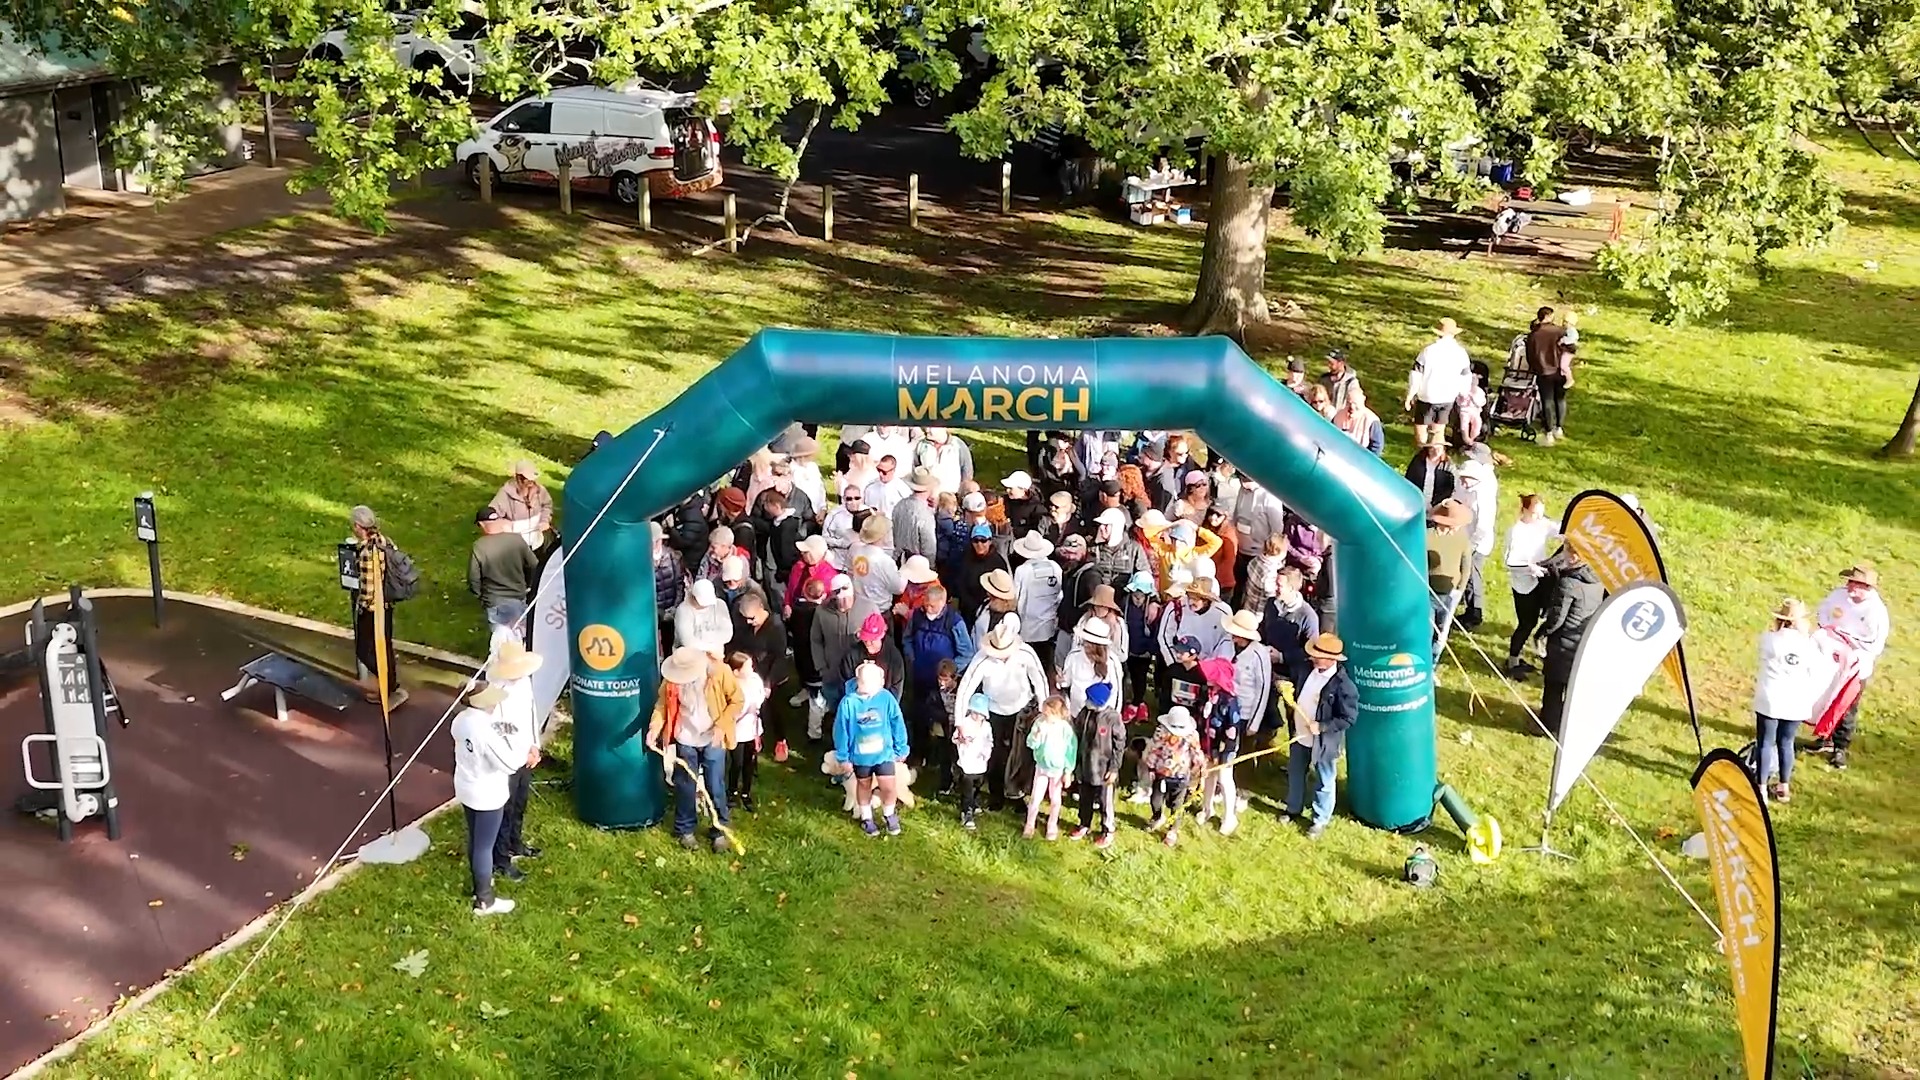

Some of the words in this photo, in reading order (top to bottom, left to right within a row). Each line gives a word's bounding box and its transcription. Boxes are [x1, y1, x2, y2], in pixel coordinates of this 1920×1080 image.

[898, 365, 1090, 385] MELANOMA
[898, 387, 1090, 422] MARCH
[1353, 665, 1415, 680] Melanoma
[606, 678, 640, 690] TODAY
[1355, 676, 1391, 689] Institute
[1712, 789, 1760, 947] MARCH
